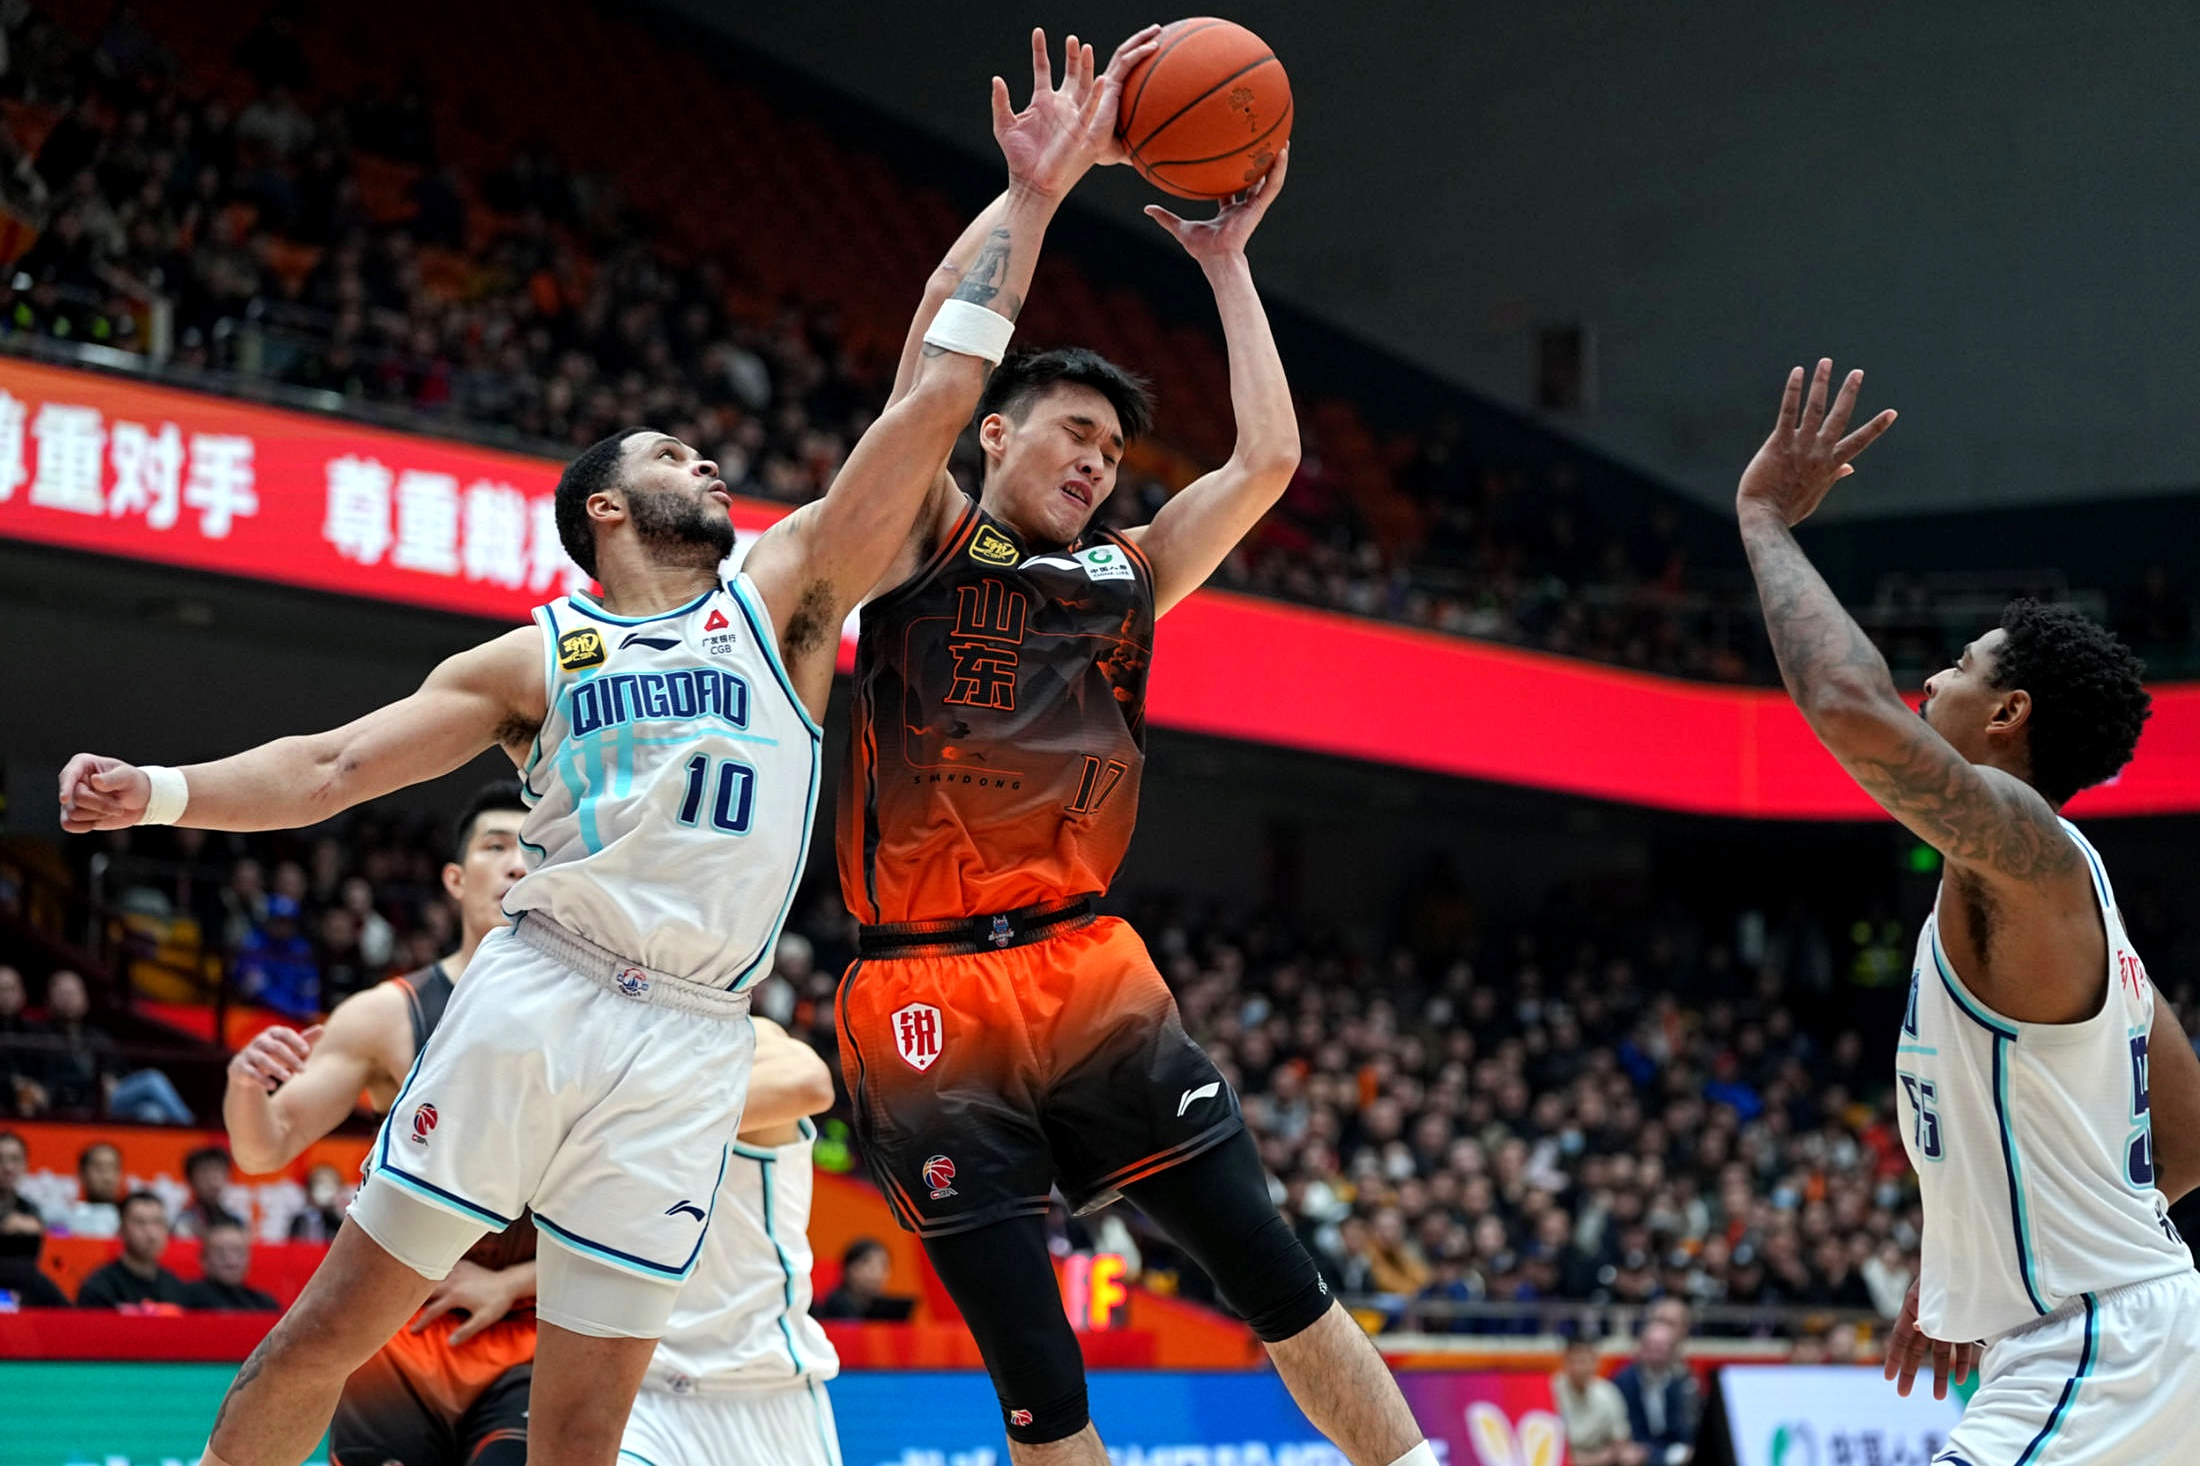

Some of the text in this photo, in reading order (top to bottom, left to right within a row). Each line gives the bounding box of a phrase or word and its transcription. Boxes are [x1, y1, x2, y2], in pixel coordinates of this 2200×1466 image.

[710, 644, 732, 655] CGB
[570, 667, 750, 739] QINGDAO
[677, 752, 757, 837] 10
[1064, 754, 1129, 815] 17
